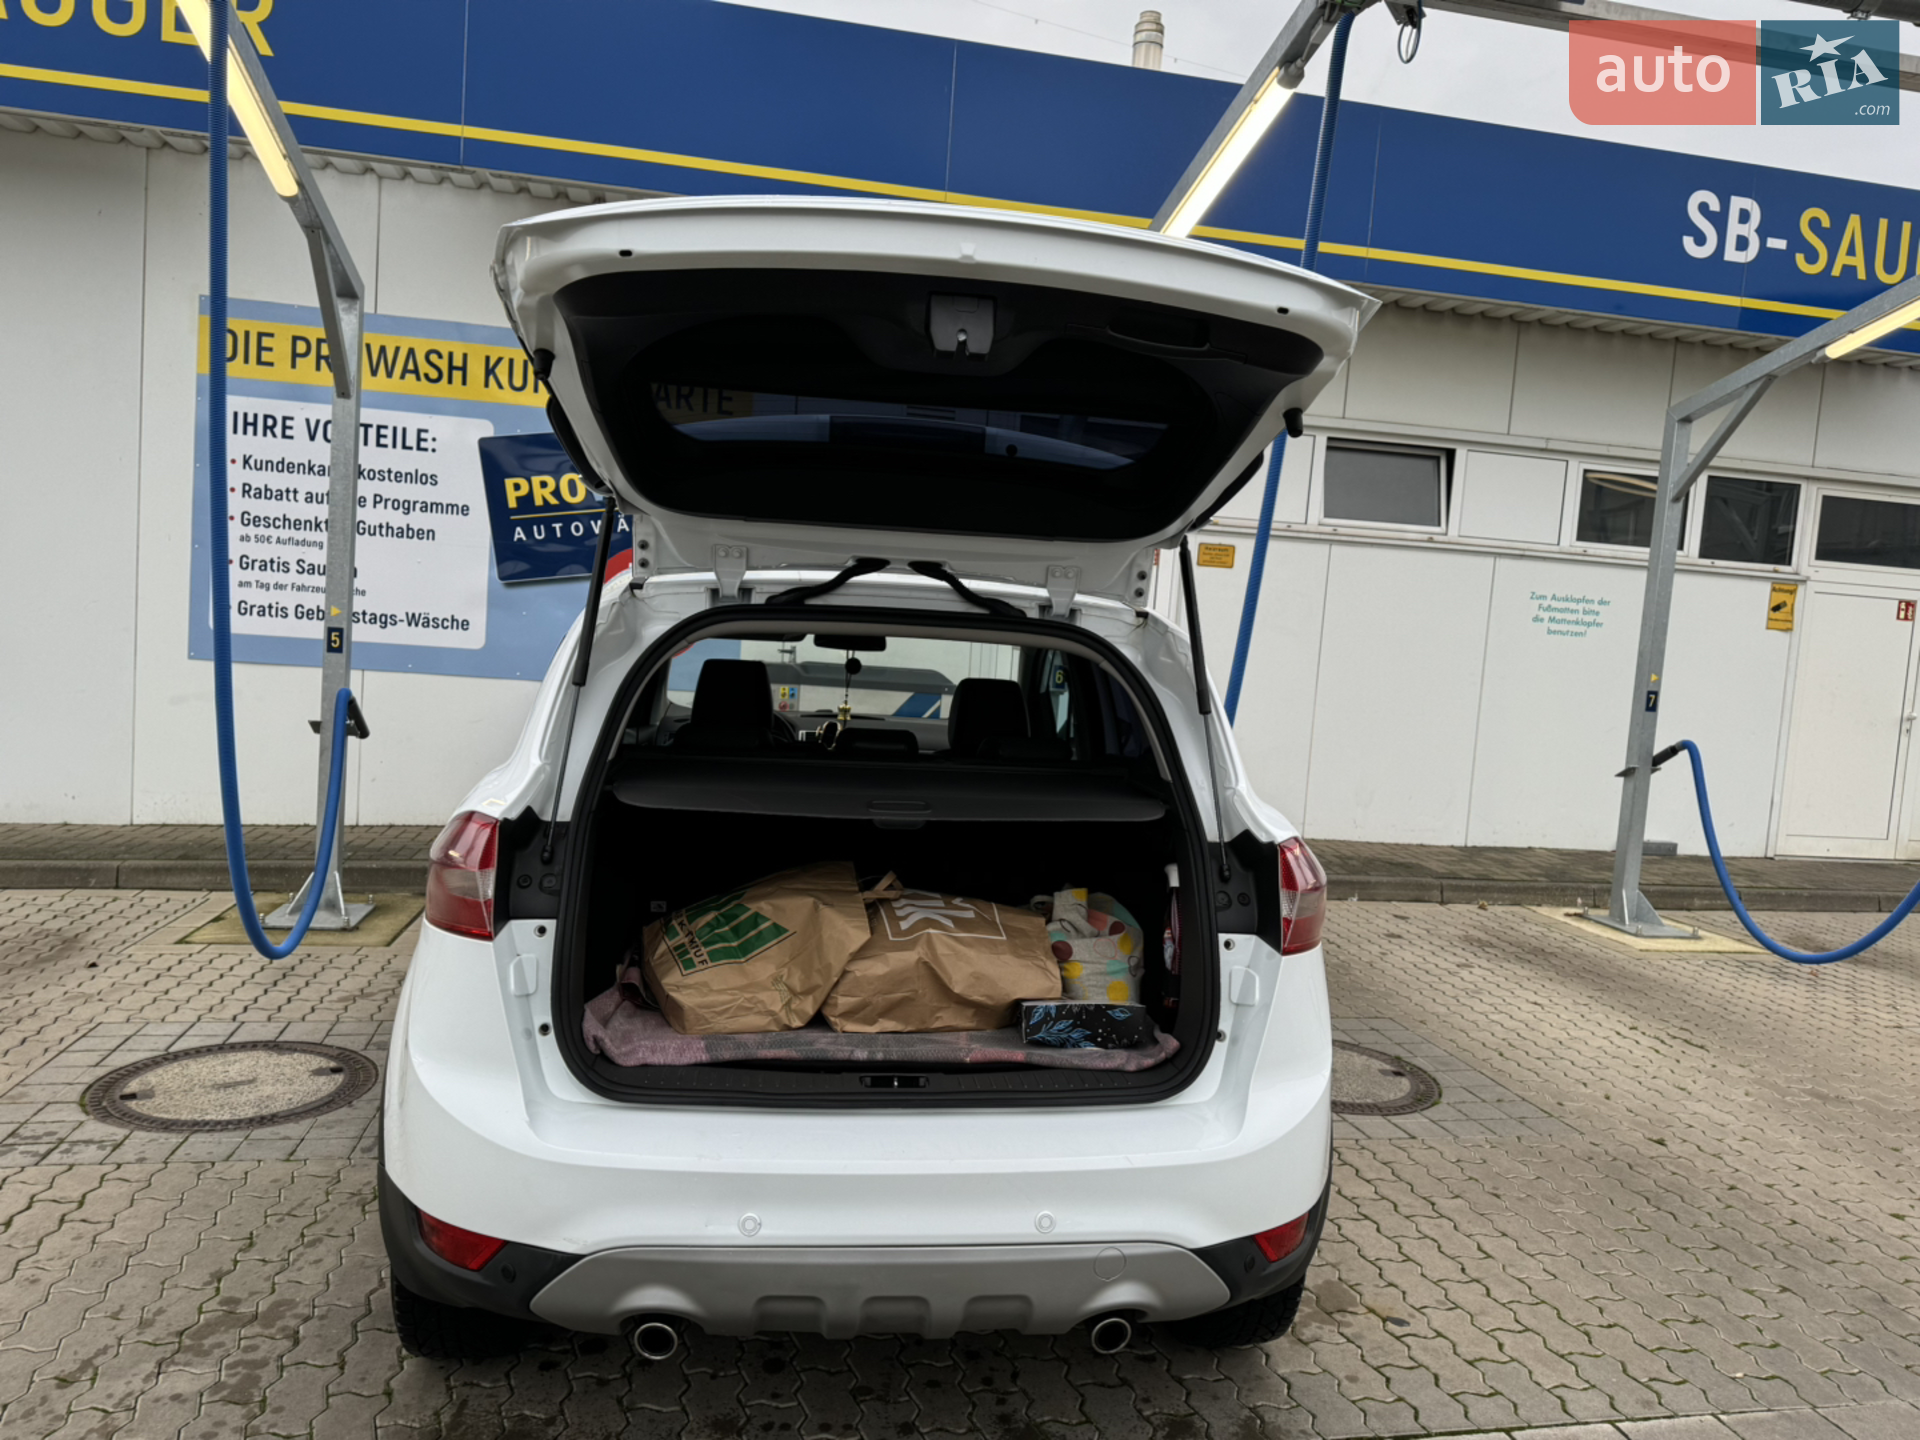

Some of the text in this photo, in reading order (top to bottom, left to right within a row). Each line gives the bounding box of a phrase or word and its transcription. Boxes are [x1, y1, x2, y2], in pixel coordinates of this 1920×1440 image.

[1682, 189, 1920, 285] SB-SAU
[291, 335, 469, 387] PRWASH
[232, 411, 438, 454] IHRE VOTEILE:
[358, 464, 439, 486] kostenlos
[241, 482, 299, 502] Rabatt
[373, 493, 470, 517] Programme
[356, 520, 436, 541] Guthaben
[239, 533, 324, 550] ab 50€ Aufladung
[238, 554, 291, 574] Gratis
[237, 580, 252, 589] am
[255, 579, 270, 591] Tag
[273, 581, 289, 591] der
[1530, 592, 1611, 606] Zum Ausklopfen der
[237, 599, 289, 619] Gratis
[1538, 604, 1600, 616] Fußmatten bitte
[1532, 615, 1603, 628] die Mattenklopfer
[330, 631, 341, 648] 5
[1546, 626, 1588, 637] benutzen!
[1055, 669, 1064, 684] 6
[1648, 693, 1657, 708] 7
